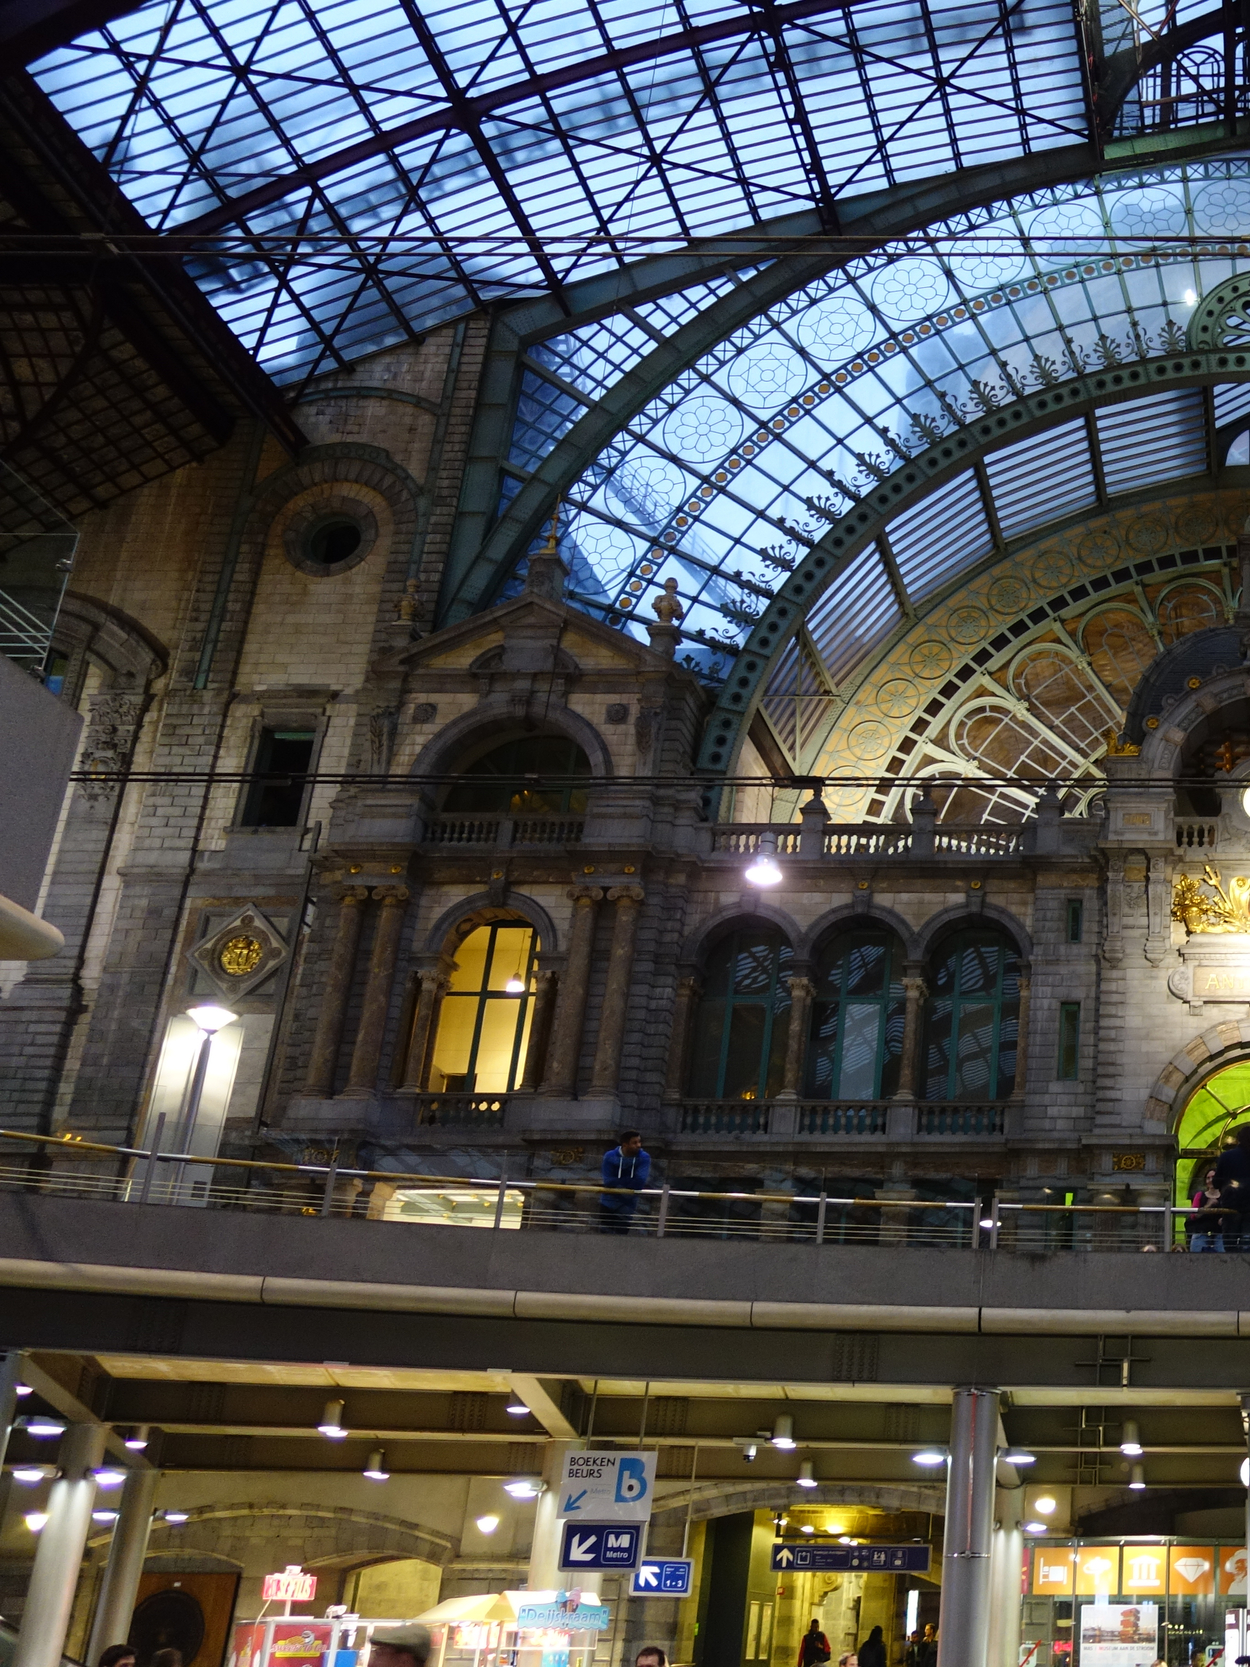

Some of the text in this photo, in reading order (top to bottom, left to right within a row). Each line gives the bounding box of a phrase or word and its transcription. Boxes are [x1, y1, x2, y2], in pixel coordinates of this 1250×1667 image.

[569, 1456, 617, 1467] BOEKEN
[567, 1468, 603, 1479] BEURS
[607, 1533, 631, 1548] M
[605, 1550, 629, 1559] Metro
